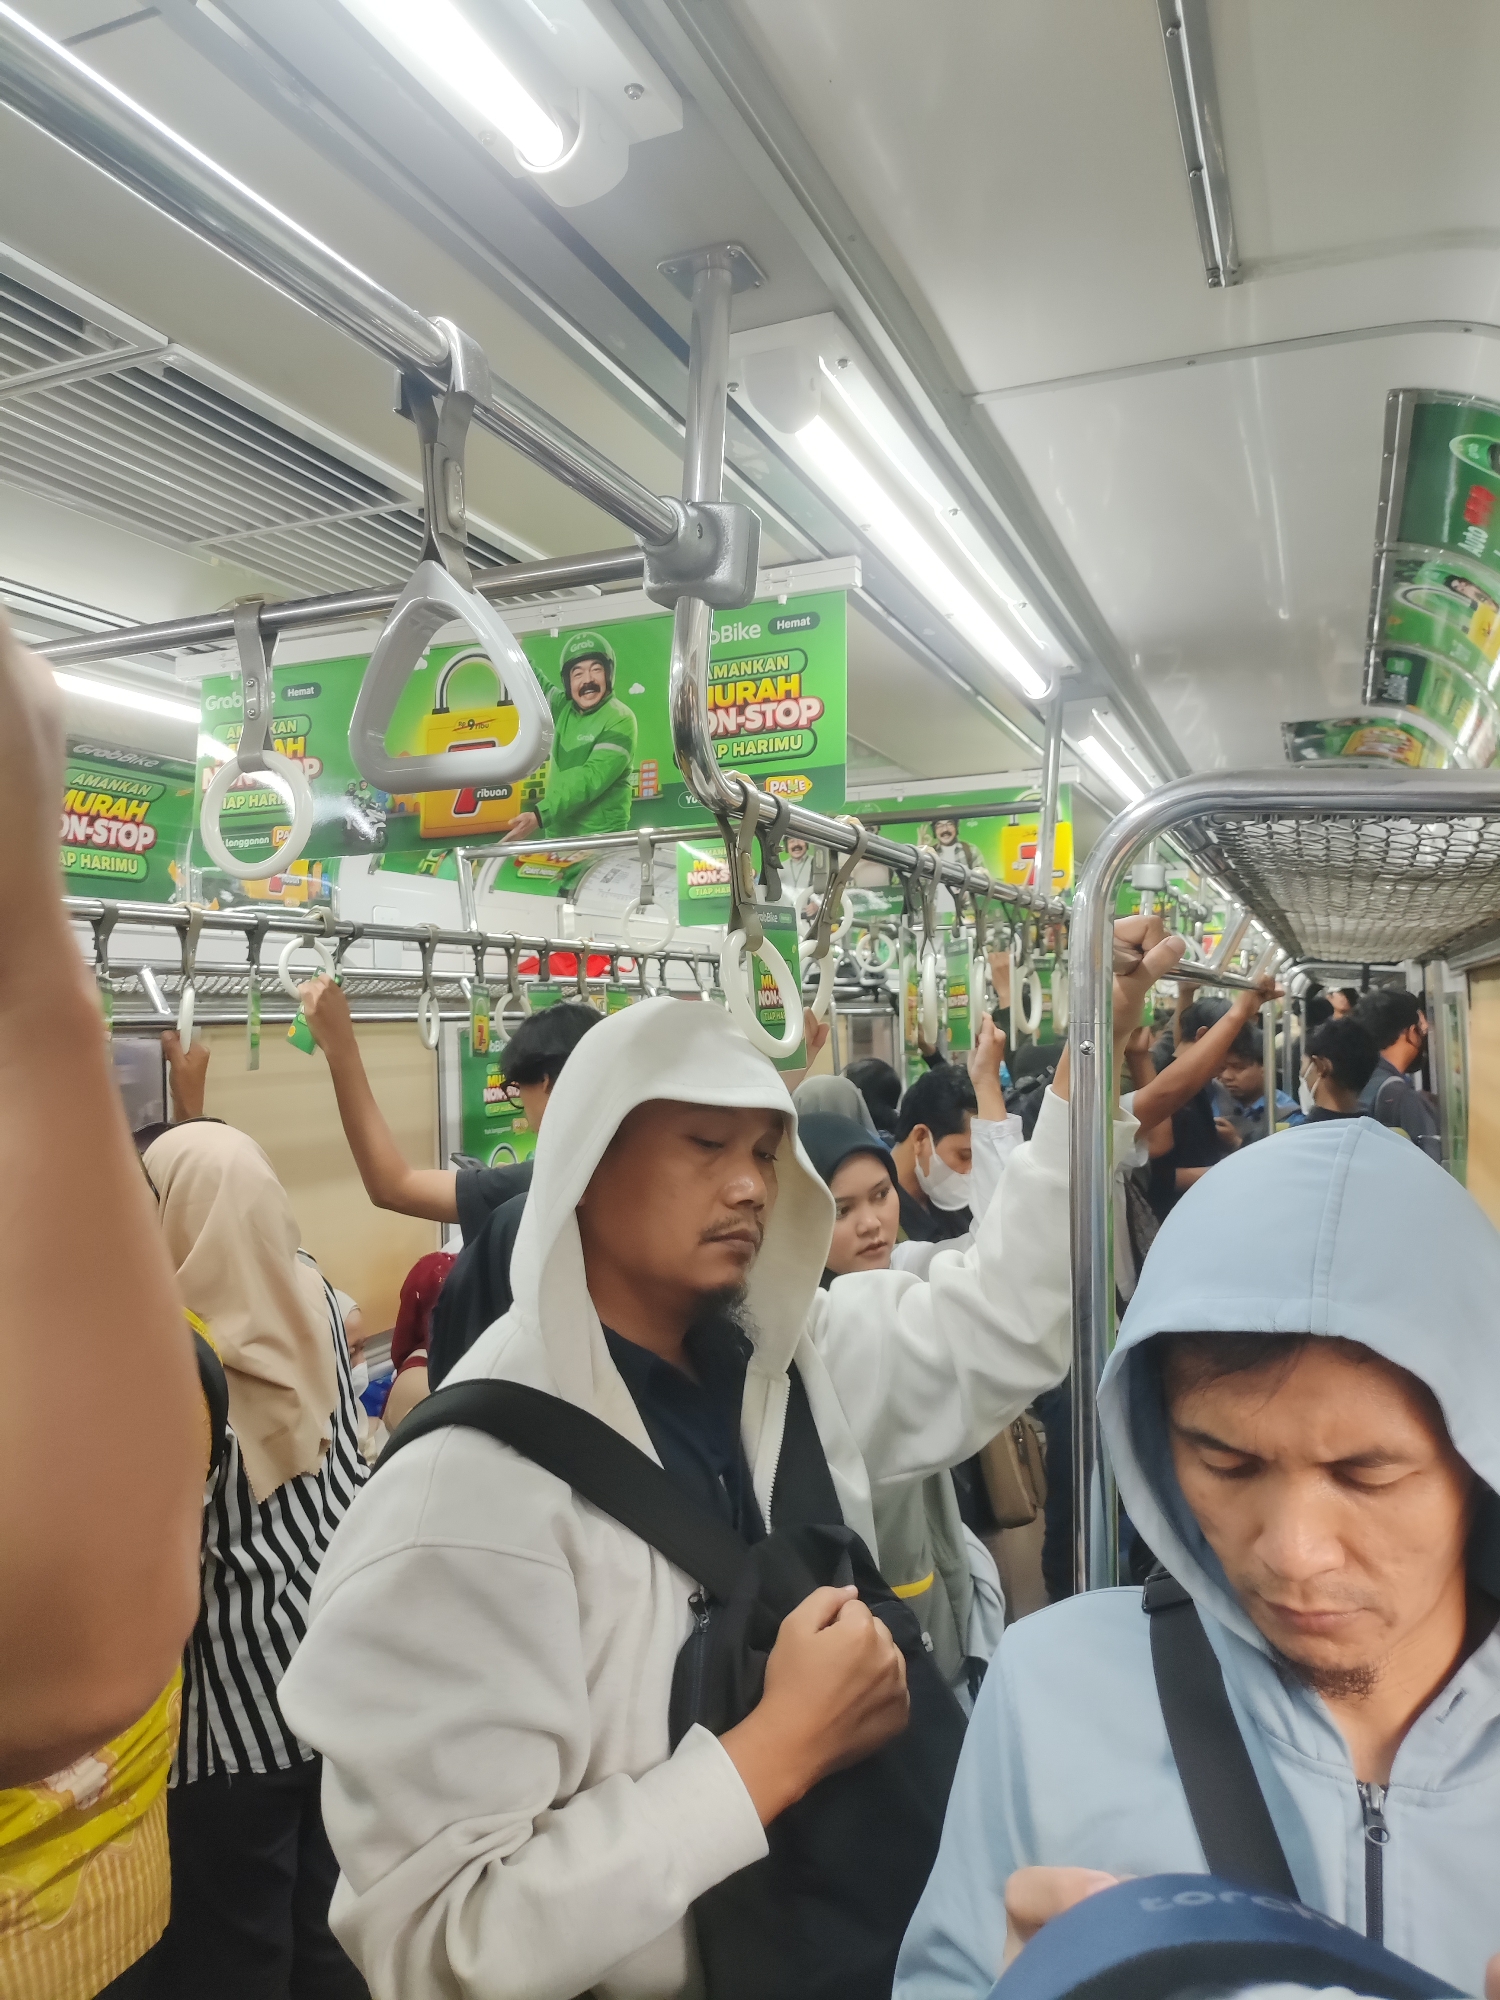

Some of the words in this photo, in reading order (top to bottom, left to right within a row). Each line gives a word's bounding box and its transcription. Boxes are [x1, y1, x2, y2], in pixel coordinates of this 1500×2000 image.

[776, 616, 811, 630] Hemat
[570, 640, 595, 653] Grab
[287, 686, 315, 698] Hemat
[467, 719, 476, 731] 9
[576, 733, 595, 742] Grab
[732, 734, 802, 757] HARIMU
[72, 743, 160, 768] GrabBike
[71, 773, 152, 797] AMANKAN
[476, 788, 508, 798] ribuan
[685, 795, 700, 805] Yu
[222, 796, 246, 810] IAP
[80, 853, 139, 875] HARIMU
[686, 870, 731, 886] NON-S
